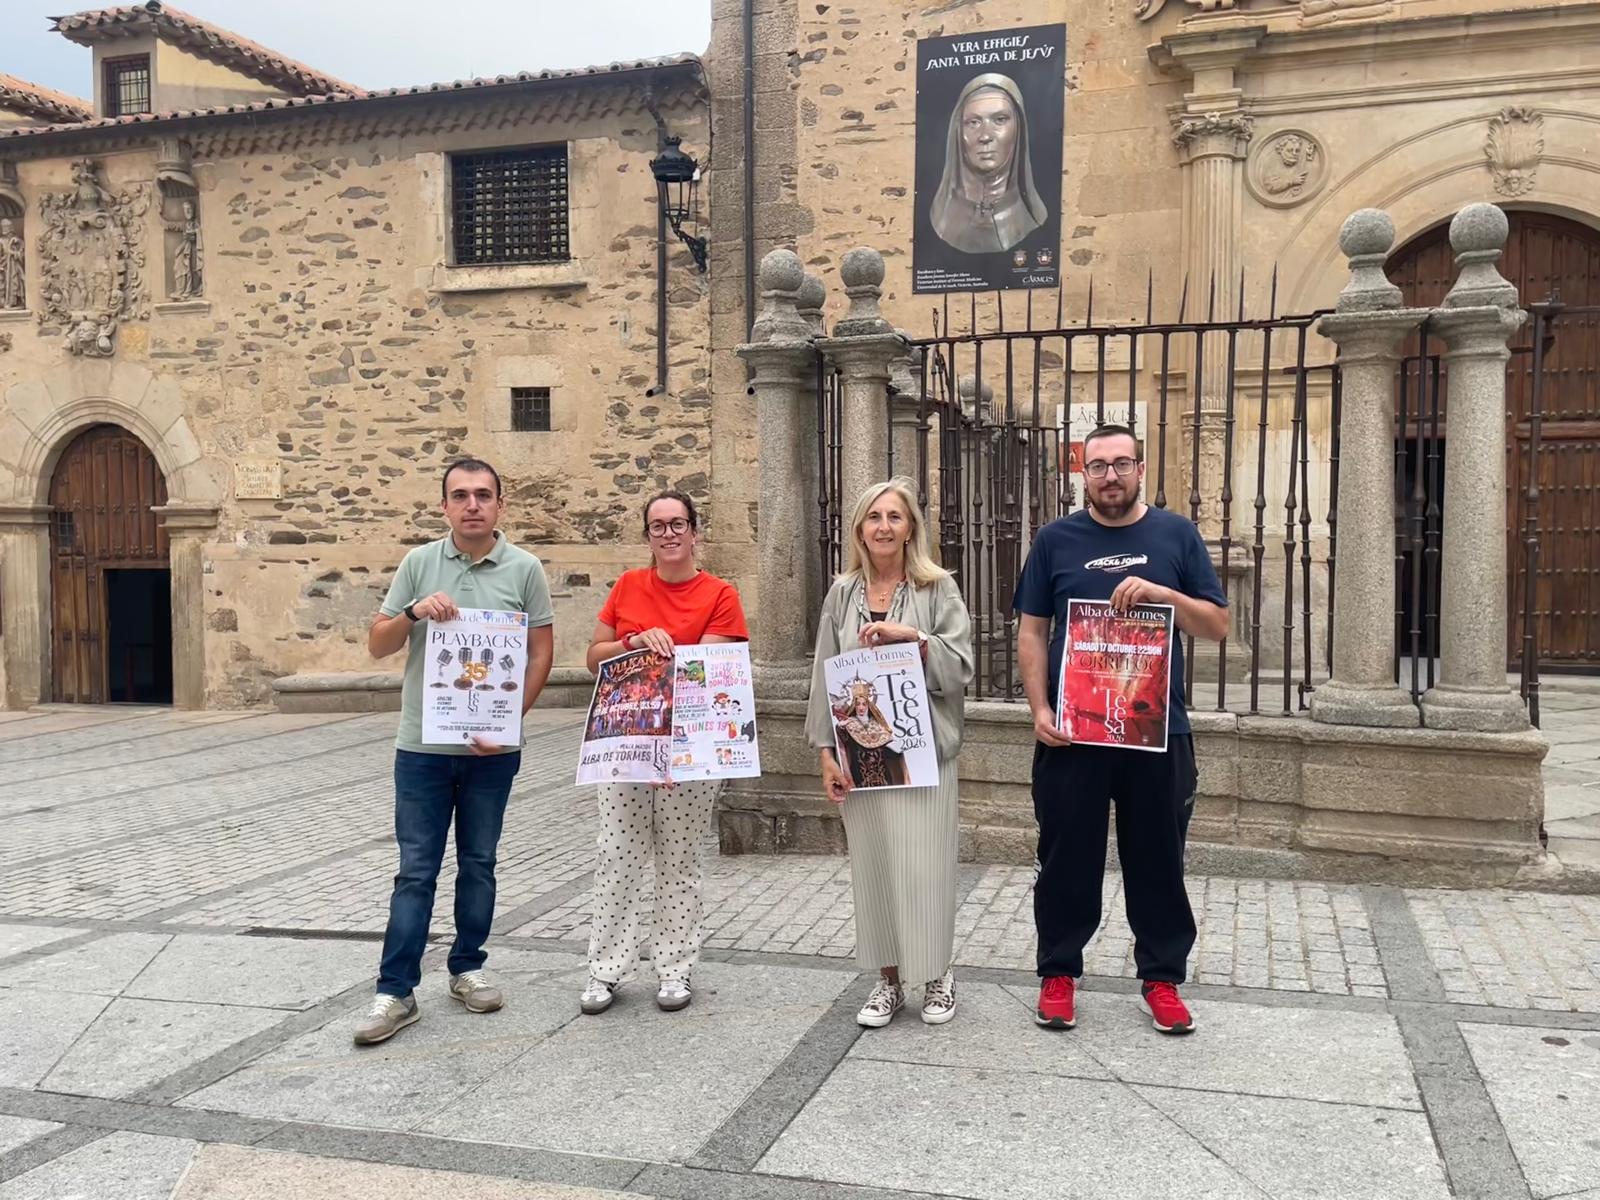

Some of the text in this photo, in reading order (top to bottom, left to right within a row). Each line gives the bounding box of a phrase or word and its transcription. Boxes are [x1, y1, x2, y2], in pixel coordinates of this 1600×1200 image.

[952, 35, 1029, 53] VERA EFFIGIES
[925, 57, 960, 71] SANTA
[964, 52, 1000, 65] TERESA
[1004, 50, 1018, 61] DE
[1076, 605, 1101, 617] Alba
[1103, 606, 1118, 617] de
[432, 631, 522, 649] PLAYBACKS
[1099, 643, 1107, 651] 17
[1107, 643, 1136, 654] OCTUBRE
[833, 658, 855, 669] Alba
[857, 653, 870, 664] de
[875, 649, 913, 662] Tormes
[687, 721, 715, 733] LUNES
[900, 738, 927, 751] 2026
[1104, 734, 1125, 743] 2026
[581, 750, 652, 766] ALBA DE TORMES
